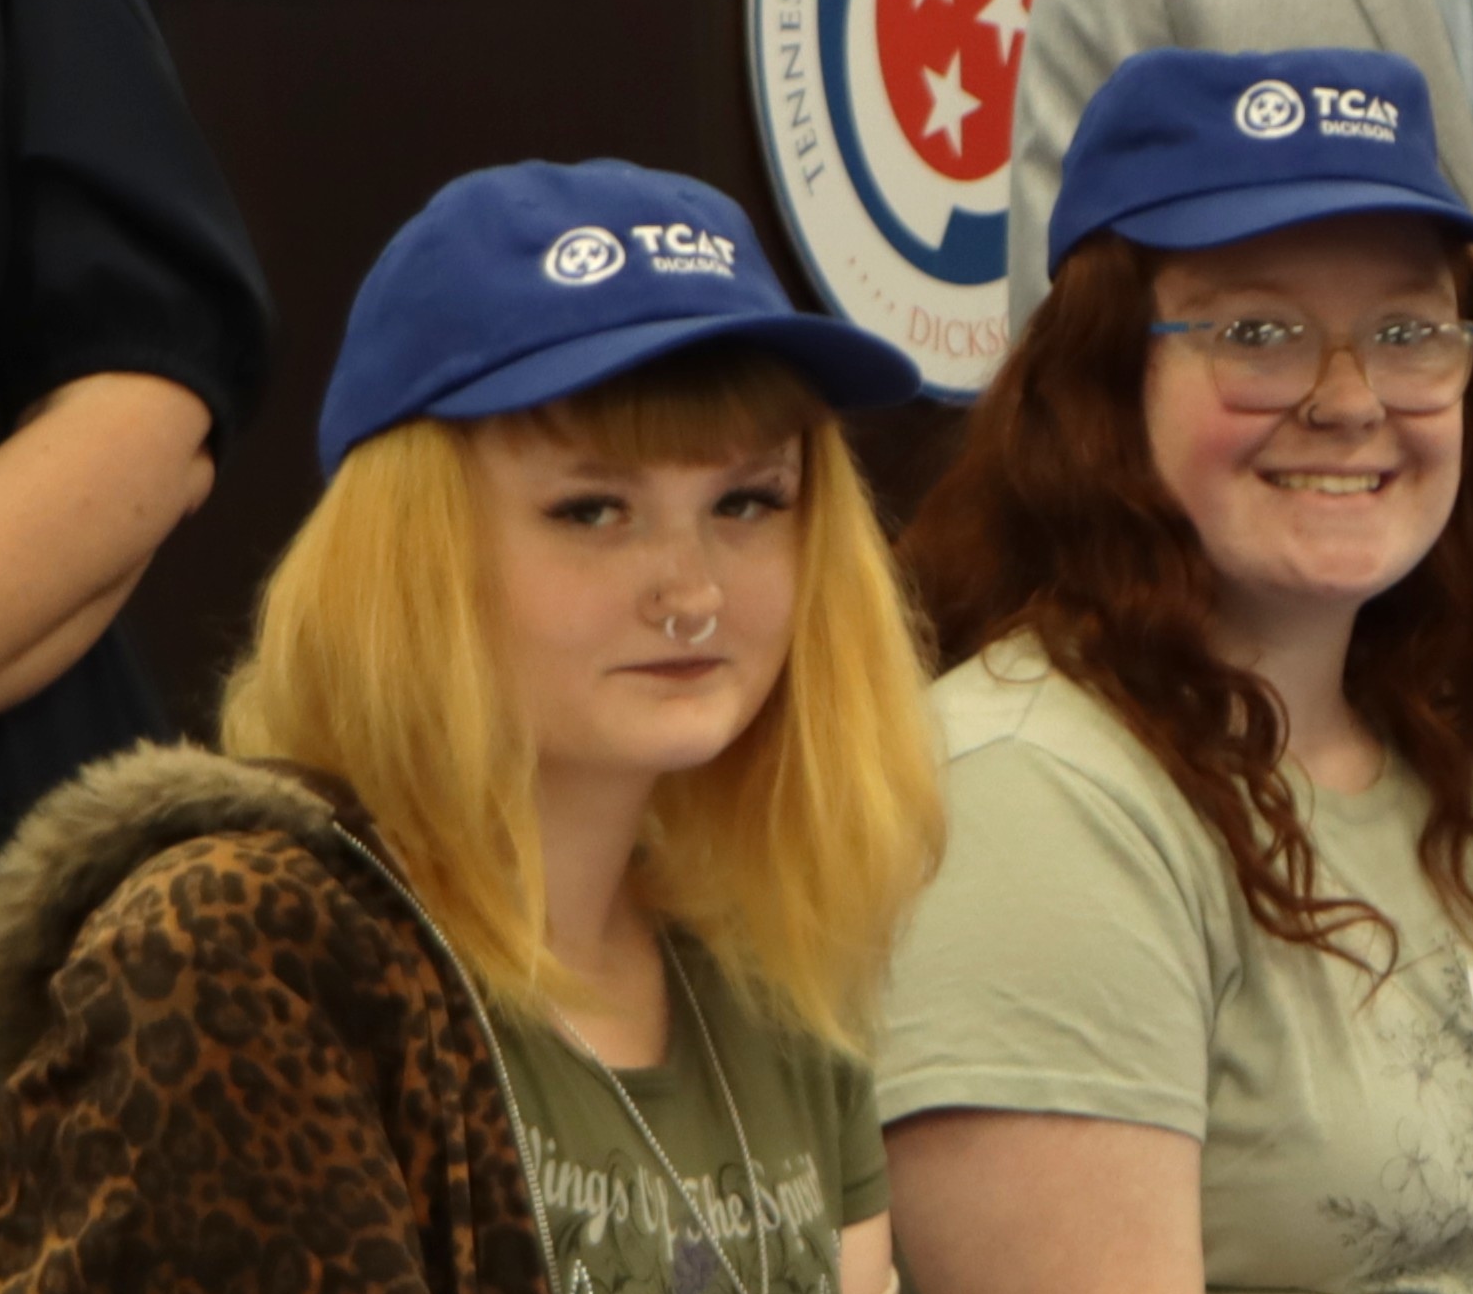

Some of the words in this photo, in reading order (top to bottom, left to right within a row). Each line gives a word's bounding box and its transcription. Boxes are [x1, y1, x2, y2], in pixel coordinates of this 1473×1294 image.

[1312, 86, 1399, 128] TCAT
[1320, 118, 1395, 144] DICKSON
[631, 222, 735, 265] TCAT
